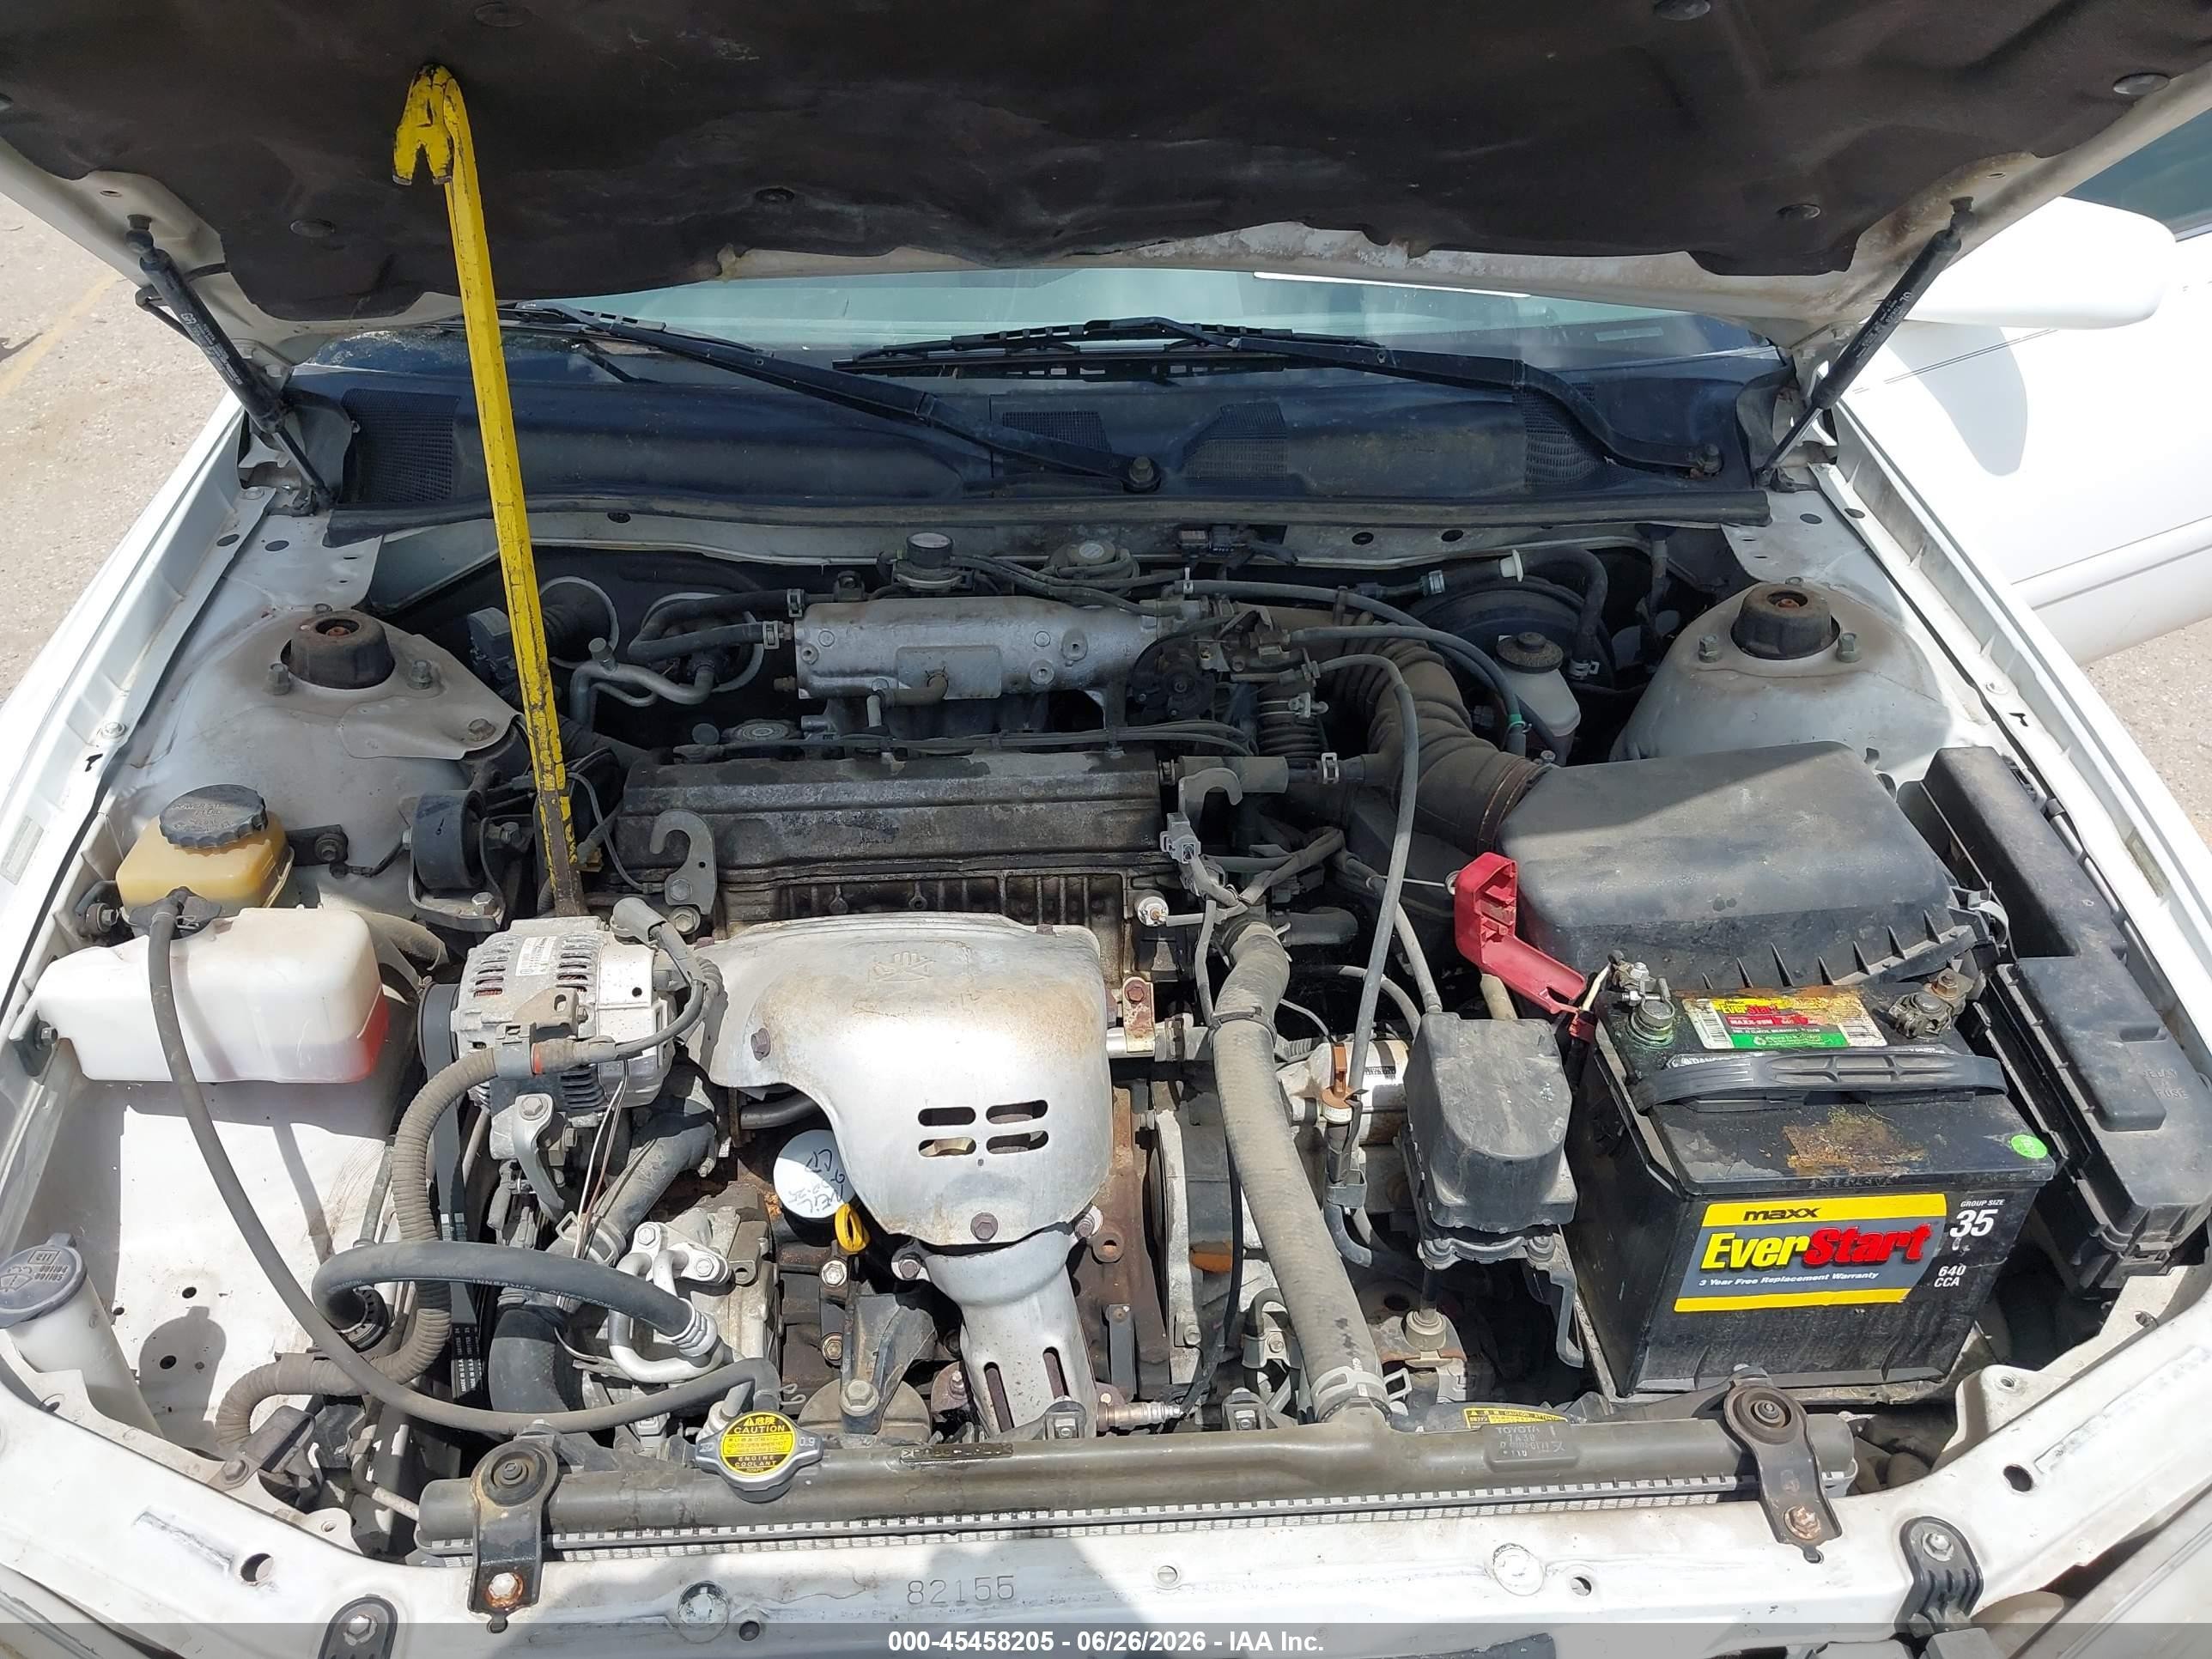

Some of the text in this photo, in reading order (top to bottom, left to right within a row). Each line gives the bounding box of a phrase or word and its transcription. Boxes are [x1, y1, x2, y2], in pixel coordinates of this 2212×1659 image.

[1743, 1207, 1821, 1222] maxx
[1949, 1209, 1999, 1237] 35
[1700, 1224, 1931, 1270] EverStart
[1938, 1265, 1966, 1277] 640
[1710, 1278, 1734, 1286] Year
[1760, 1274, 1830, 1285] Replacement
[1832, 1271, 1880, 1280] Warranty
[1934, 1276, 1960, 1287] CCA
[733, 1425, 785, 1434] CAUTION
[1496, 1425, 1540, 1434] TOYOTA
[799, 1437, 816, 1447] 0.9
[907, 1575, 1015, 1604] 82155
